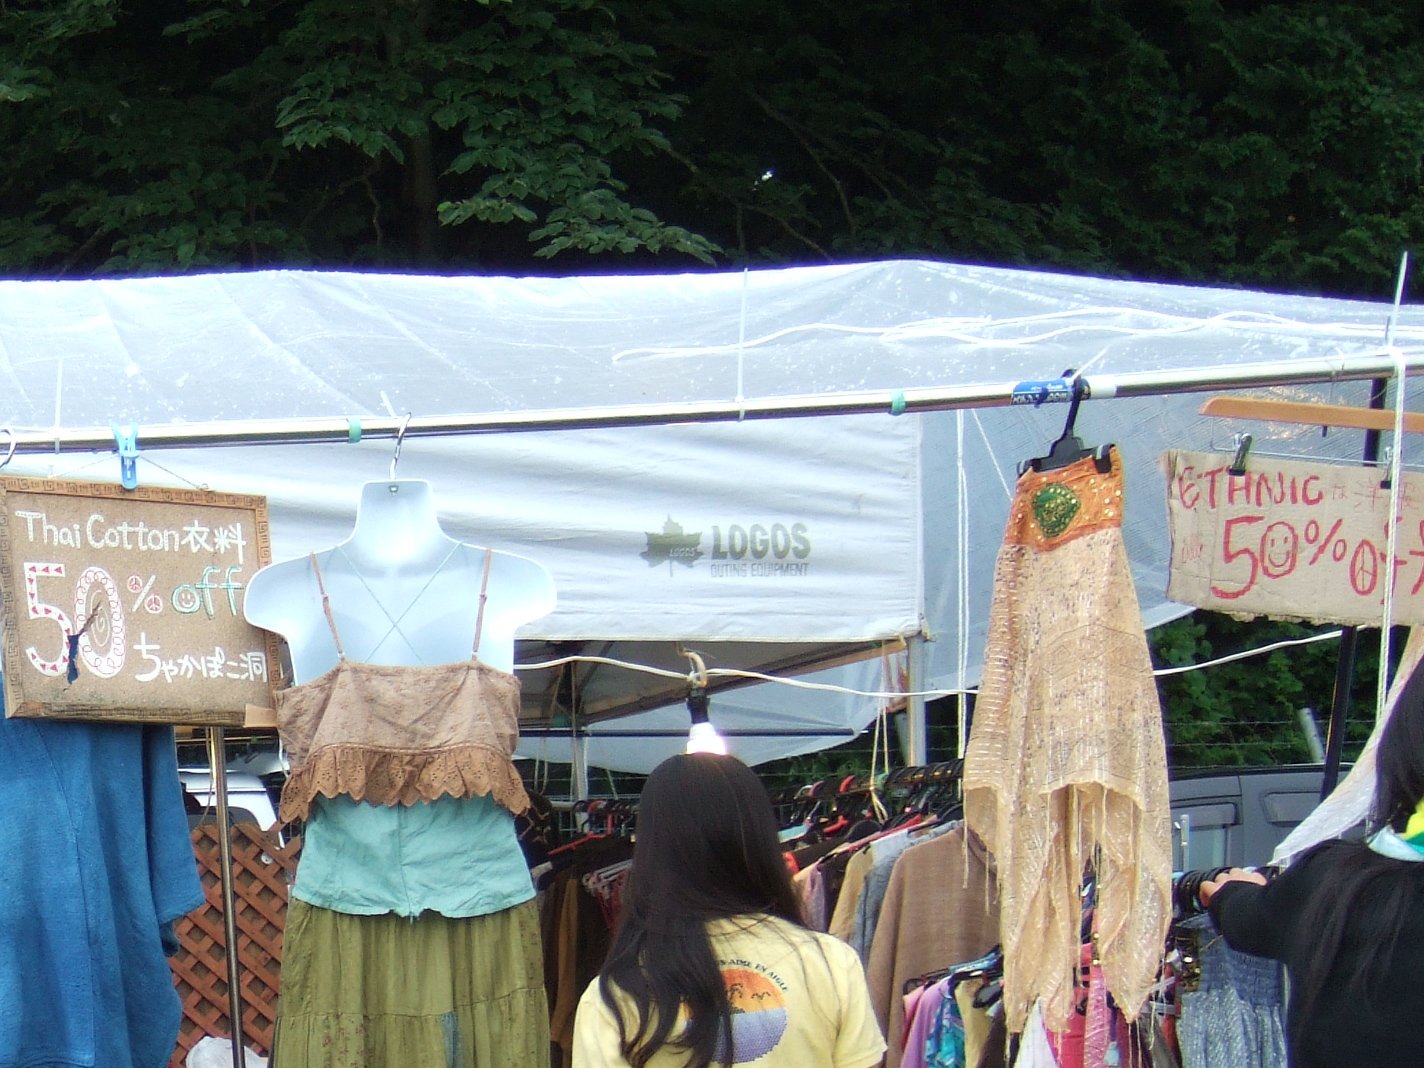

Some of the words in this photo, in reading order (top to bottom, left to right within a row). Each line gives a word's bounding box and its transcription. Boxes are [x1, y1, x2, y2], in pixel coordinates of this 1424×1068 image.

[1178, 466, 1324, 509] ETHNIC
[15, 510, 80, 549] Thai
[86, 514, 179, 551] Cotton
[711, 522, 812, 560] LOGOS
[750, 562, 810, 577] EQUIPMENT
[1210, 515, 1348, 600] 50%
